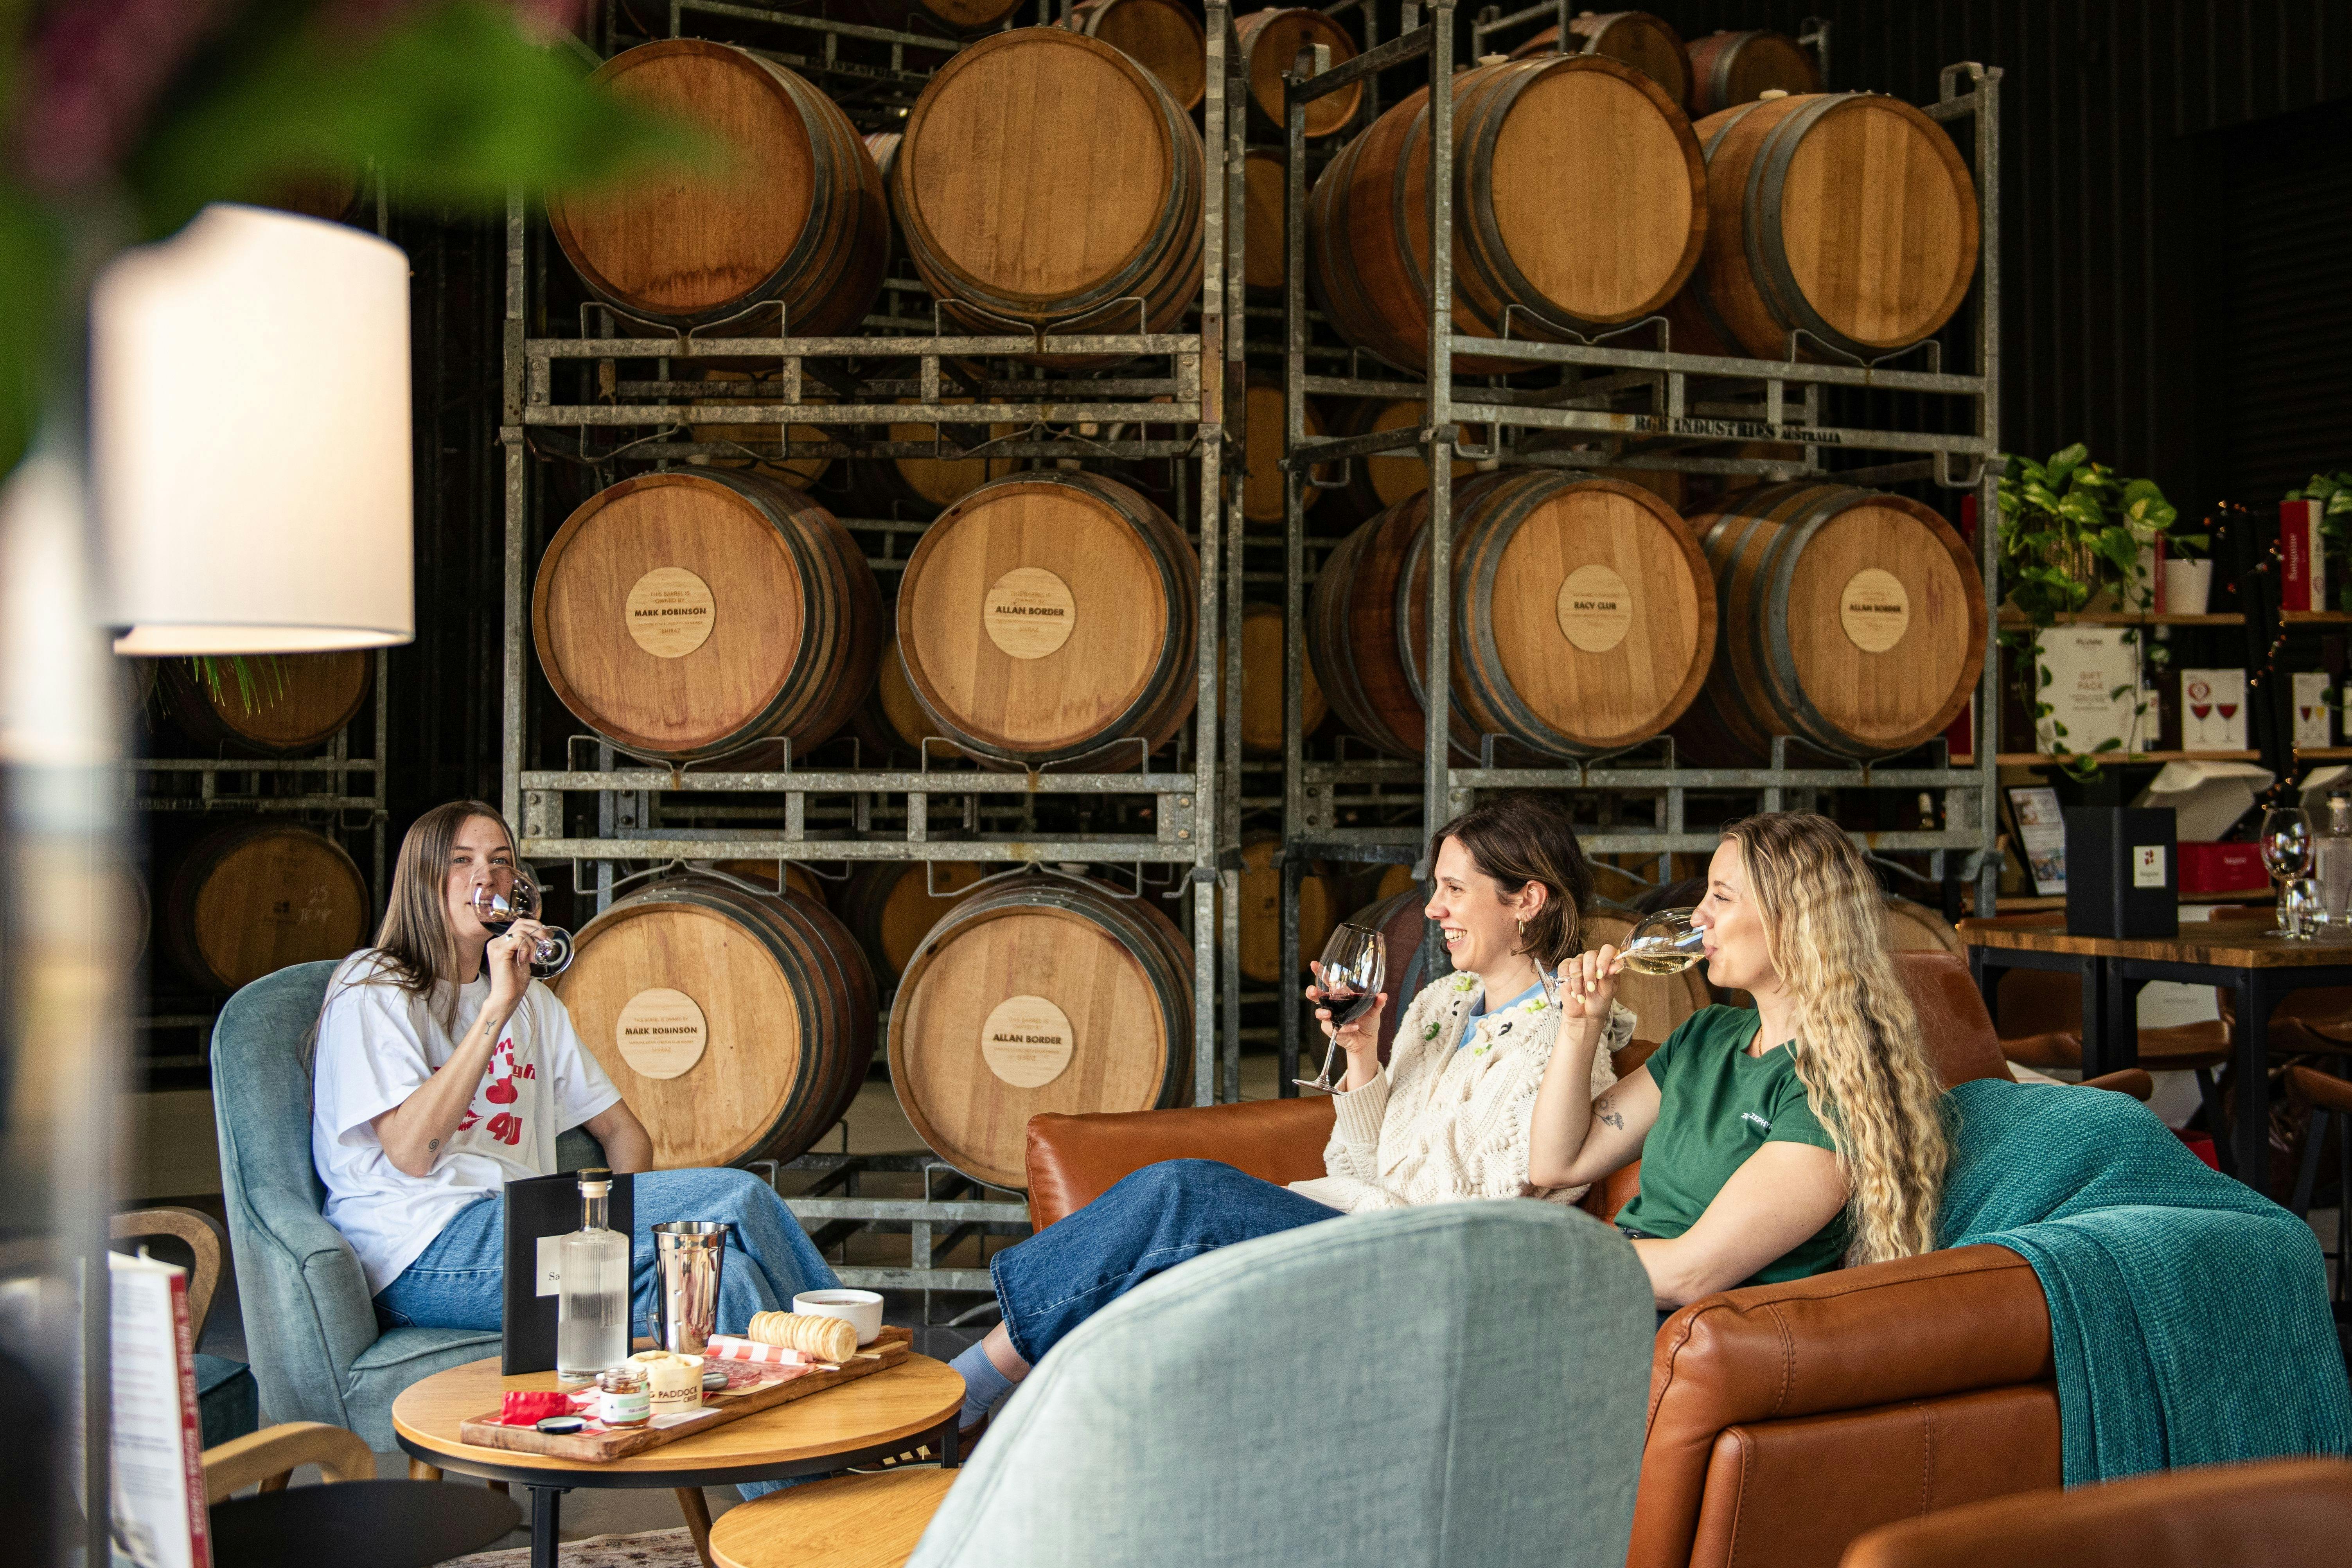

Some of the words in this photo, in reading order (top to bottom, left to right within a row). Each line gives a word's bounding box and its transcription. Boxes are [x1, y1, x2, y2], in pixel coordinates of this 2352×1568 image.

[1674, 417, 1775, 438] INDUSTRIES
[662, 607, 706, 616] ROBINSON
[995, 606, 1026, 614] ALLAN
[1028, 607, 1064, 616] BORDER
[2079, 671, 2102, 680] GIFT
[2077, 682, 2104, 690] PACK
[993, 1033, 1023, 1042] ALLAN
[1026, 1036, 1062, 1044] BORDER
[658, 1385, 697, 1399] PADDOCK
